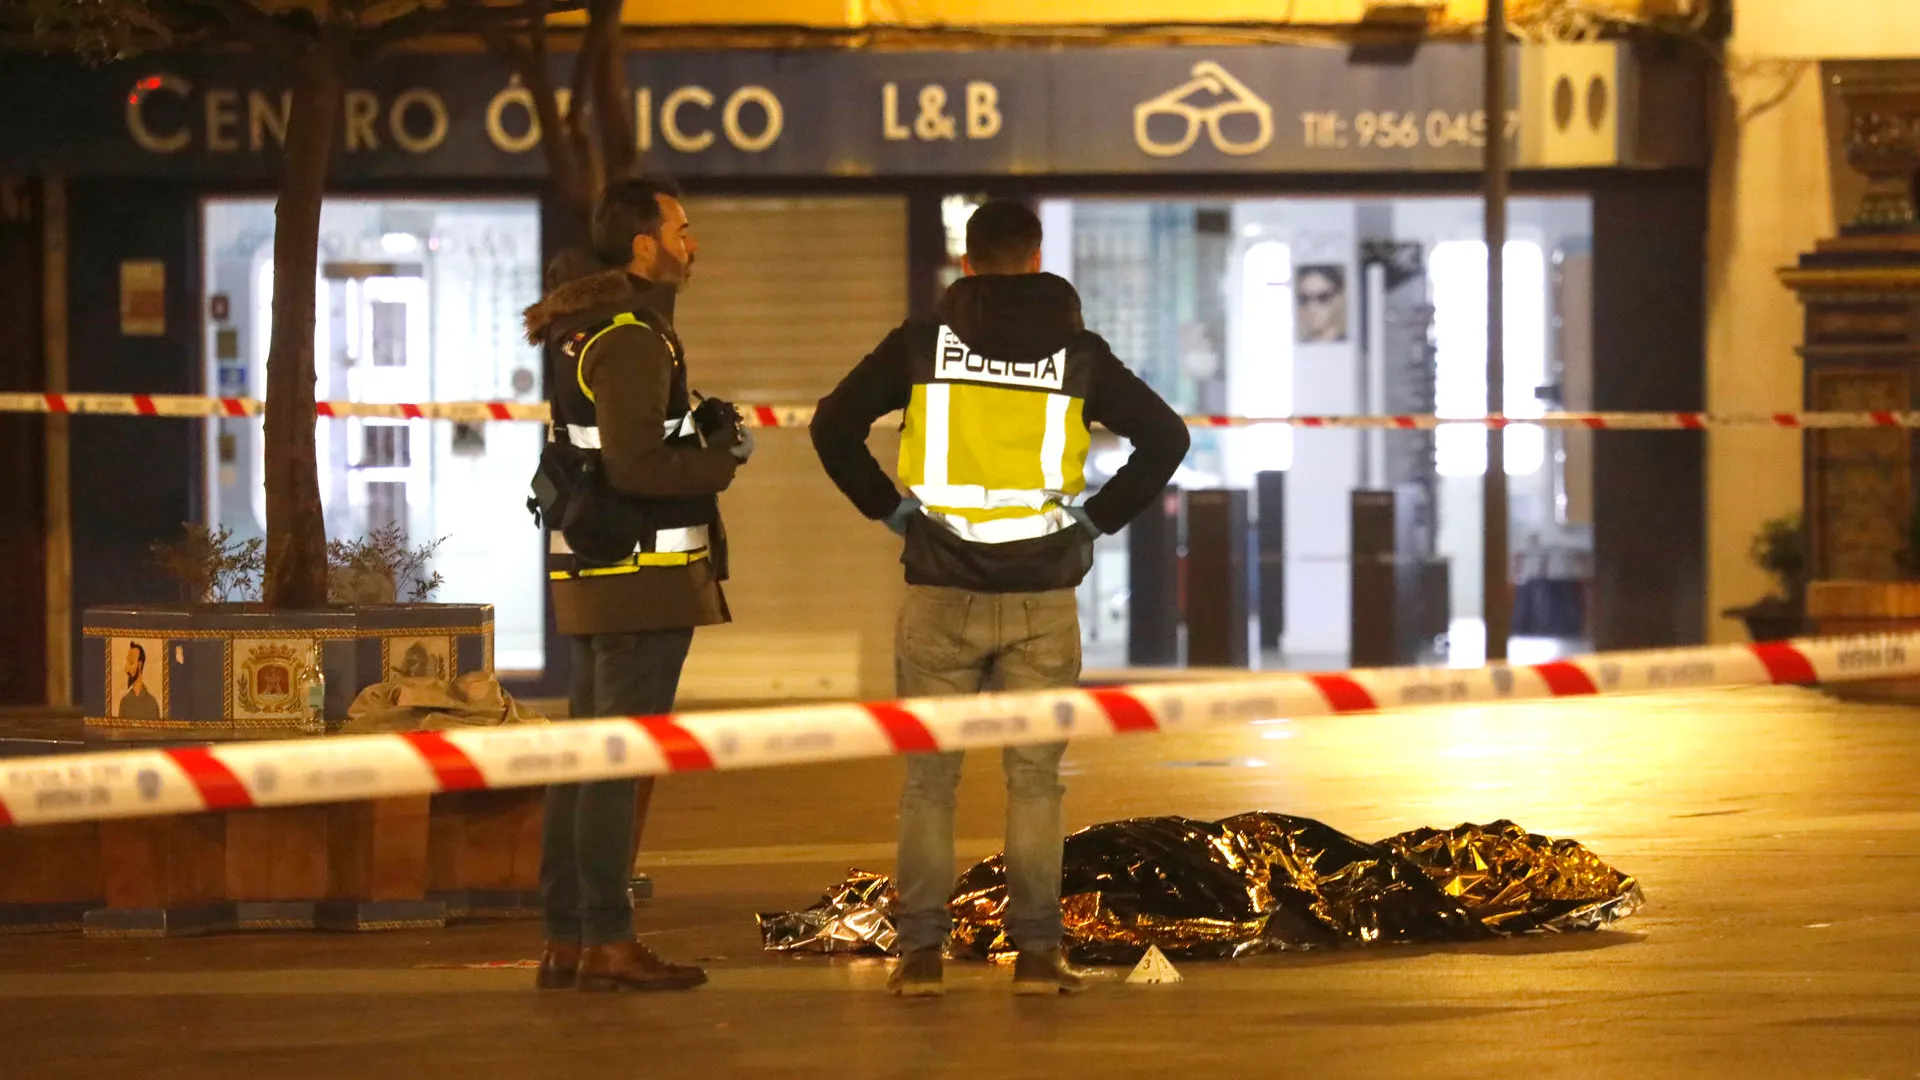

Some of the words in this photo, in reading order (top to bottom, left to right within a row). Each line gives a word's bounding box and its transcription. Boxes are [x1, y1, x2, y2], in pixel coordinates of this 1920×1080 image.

[126, 73, 448, 153] CENRO
[485, 73, 783, 153] ÓICO
[1354, 109, 1420, 148] 956
[942, 347, 1057, 381] POLICIA
